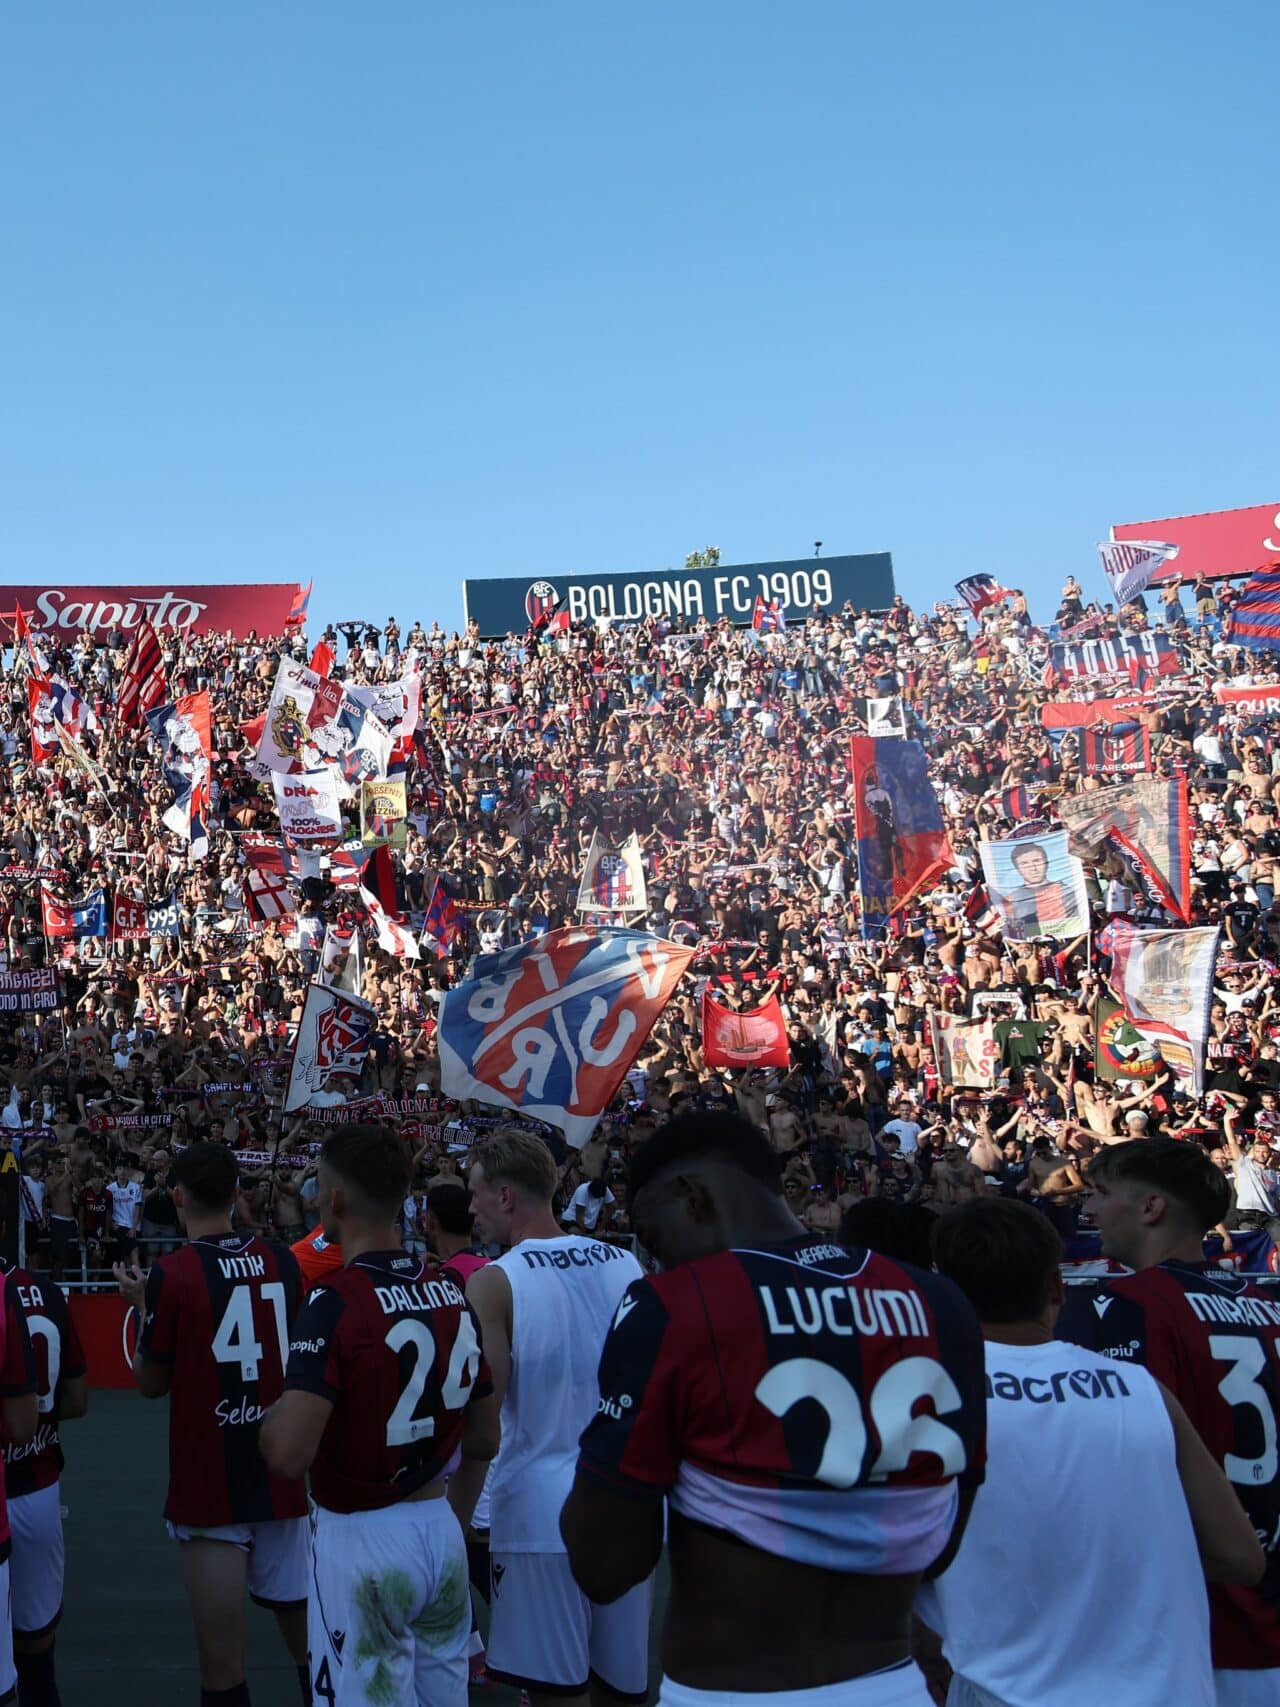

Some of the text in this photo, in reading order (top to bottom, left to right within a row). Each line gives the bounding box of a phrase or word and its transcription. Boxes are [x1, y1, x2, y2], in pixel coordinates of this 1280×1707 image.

[568, 569, 832, 622] BOLOGNA FC 1909
[29, 590, 207, 632] Saputo
[1064, 634, 1160, 676] 40059
[288, 669, 320, 692] Ama
[323, 687, 337, 703] la
[1086, 761, 1146, 772] WEAREONE
[284, 785, 319, 798] DNA
[291, 818, 320, 827] 100%
[245, 838, 284, 849] VECC
[601, 856, 624, 870] BFC
[144, 905, 177, 928] 1995
[122, 928, 171, 938] BOLOGNA
[33, 990, 58, 1008] GIRO
[382, 1097, 429, 1114] BOLOGNA
[116, 1114, 139, 1126] MUOVE
[141, 1114, 150, 1125] LA
[237, 1153, 272, 1162] TRAS
[521, 1244, 625, 1269] macron
[17, 1286, 45, 1307] EA
[758, 1284, 929, 1337] LUCUMI
[211, 1281, 290, 1382] 41
[384, 1311, 480, 1446] 24
[754, 1356, 968, 1489] 26
